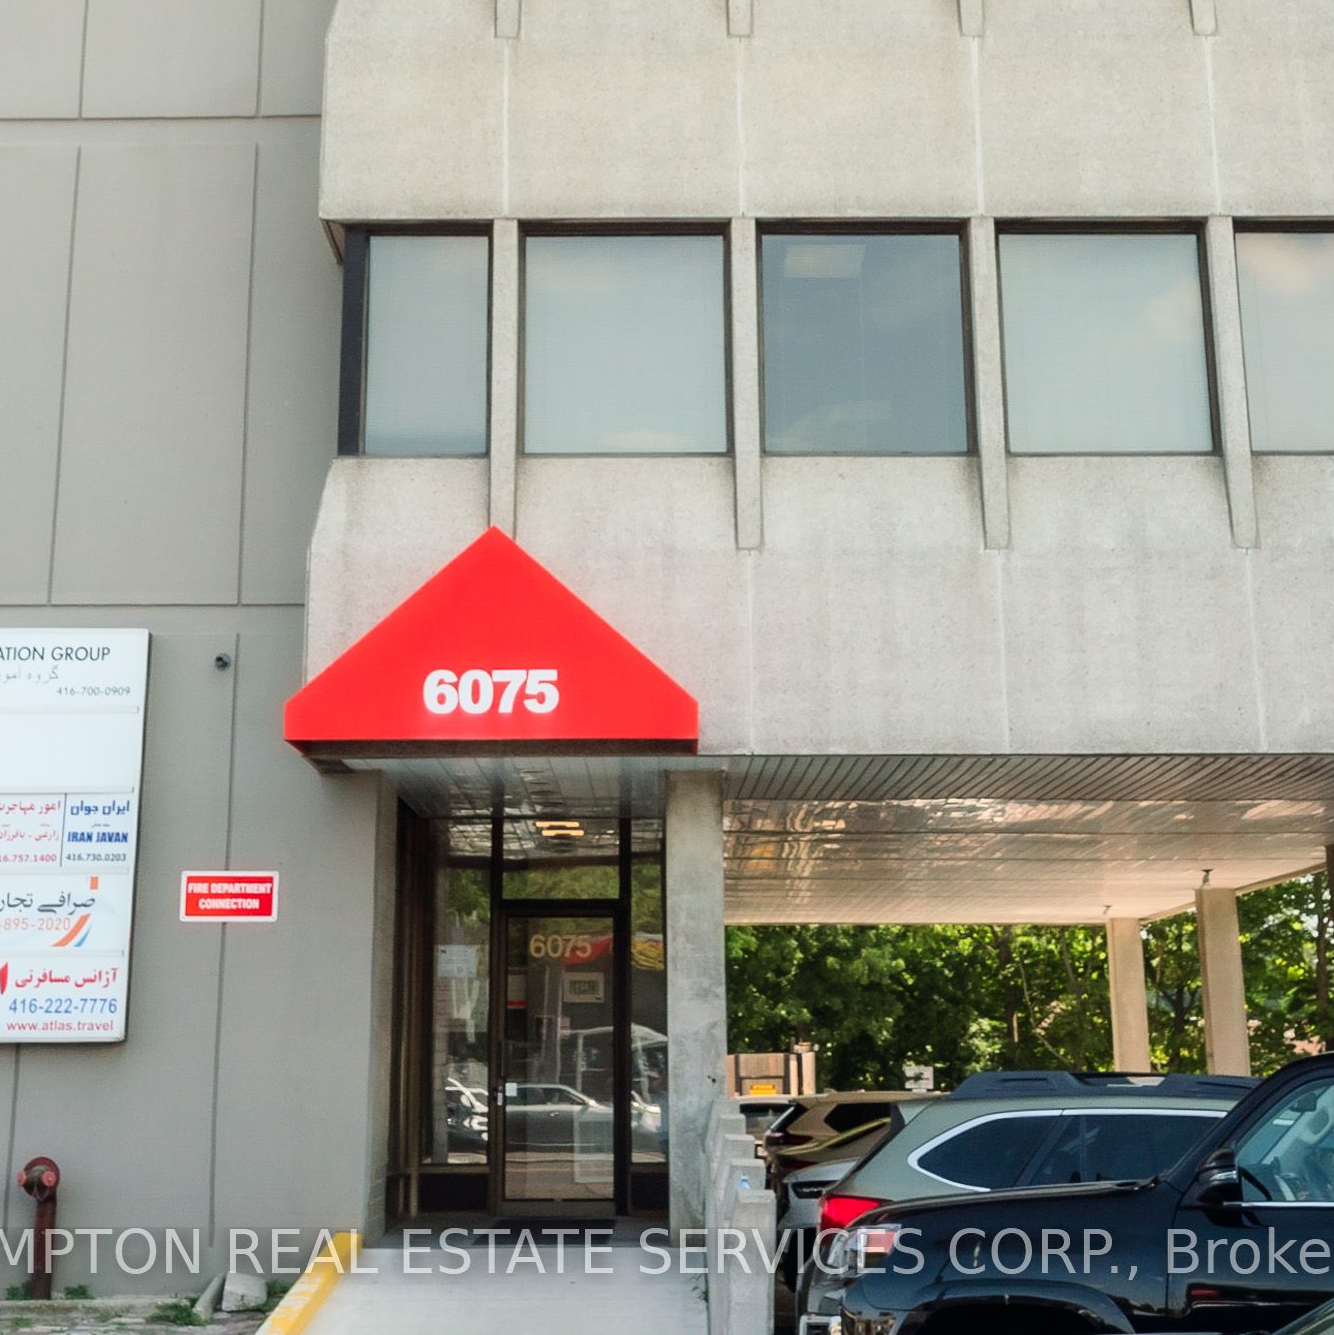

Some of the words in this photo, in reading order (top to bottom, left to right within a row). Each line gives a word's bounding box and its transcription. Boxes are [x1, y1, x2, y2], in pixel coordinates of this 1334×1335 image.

[51, 646, 111, 661] GROUP
[56, 685, 131, 697] 416-700-0909
[423, 668, 560, 714] 6075
[70, 800, 99, 815] جوان
[103, 800, 130, 815] ایران
[67, 831, 93, 843] IRAN
[96, 831, 129, 843] JAVAN
[187, 882, 209, 895] FIRE
[210, 881, 273, 894] DEPARTMENT
[198, 897, 260, 910] CONNECTION
[529, 933, 593, 959] 6075
[75, 966, 119, 987] آژانس
[9, 997, 118, 1016] 416-222-7776
[6, 1019, 114, 1033] www.atlas.travel
